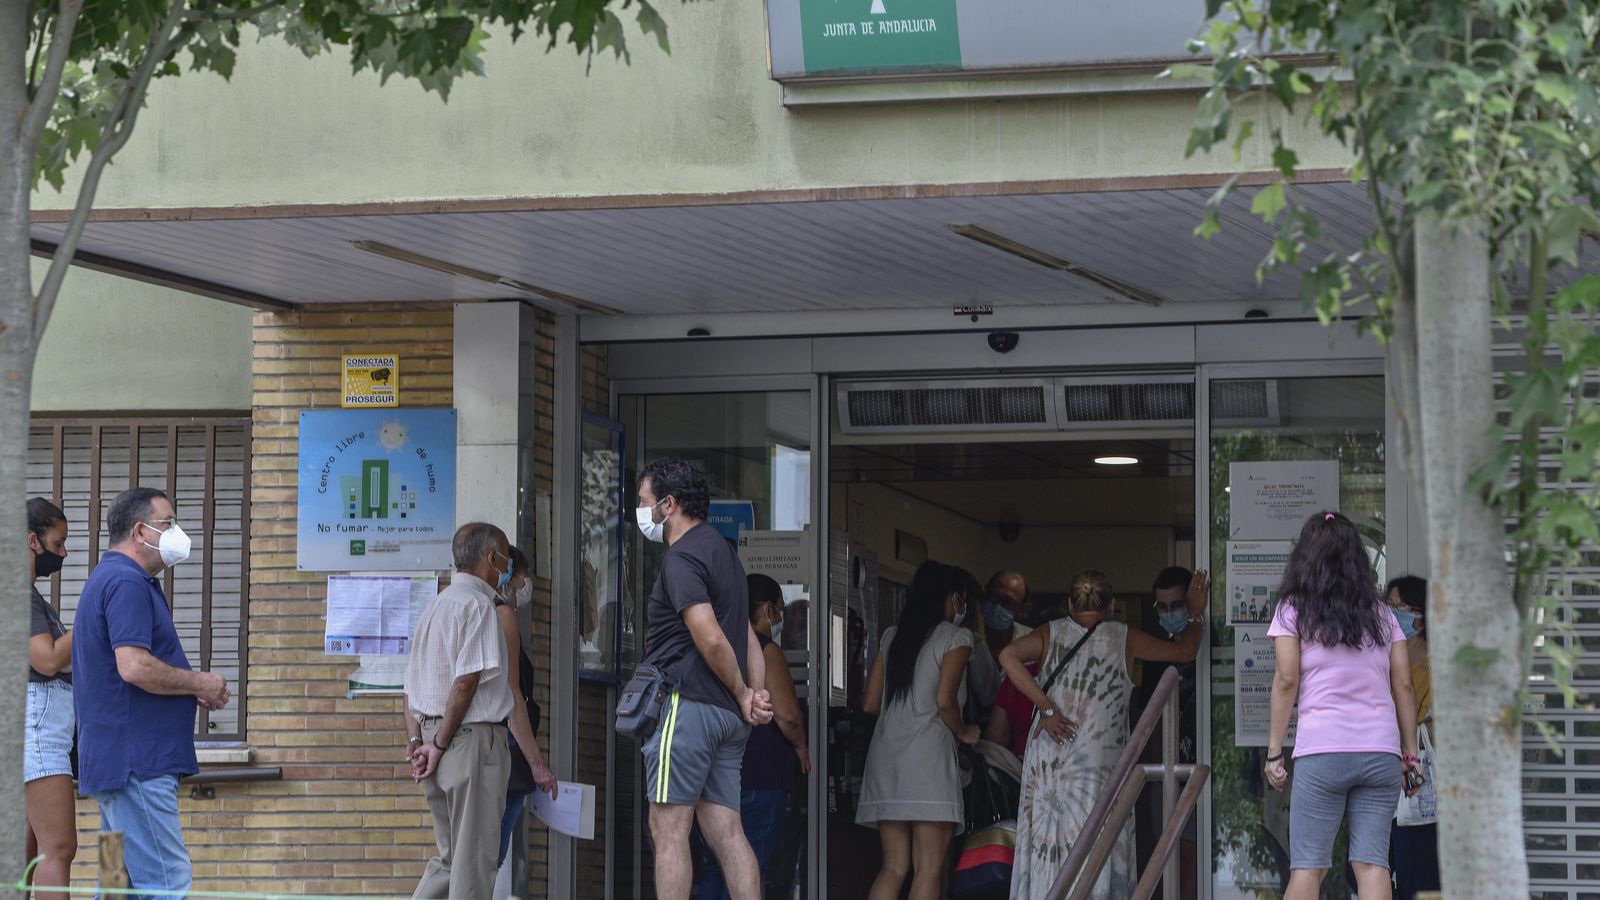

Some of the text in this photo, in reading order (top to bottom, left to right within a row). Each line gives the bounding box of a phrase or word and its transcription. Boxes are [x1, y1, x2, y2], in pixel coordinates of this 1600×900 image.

[823, 18, 937, 37] JUNTA DE ANDALUCIA
[346, 358, 394, 366] CONECTADA
[345, 396, 394, 404] PROSEGUR
[318, 431, 436, 494] Centro libre de humo
[707, 515, 733, 523] NTRADA
[317, 523, 331, 533] No
[336, 523, 369, 533] fumar
[769, 554, 801, 562] LIMITADO
